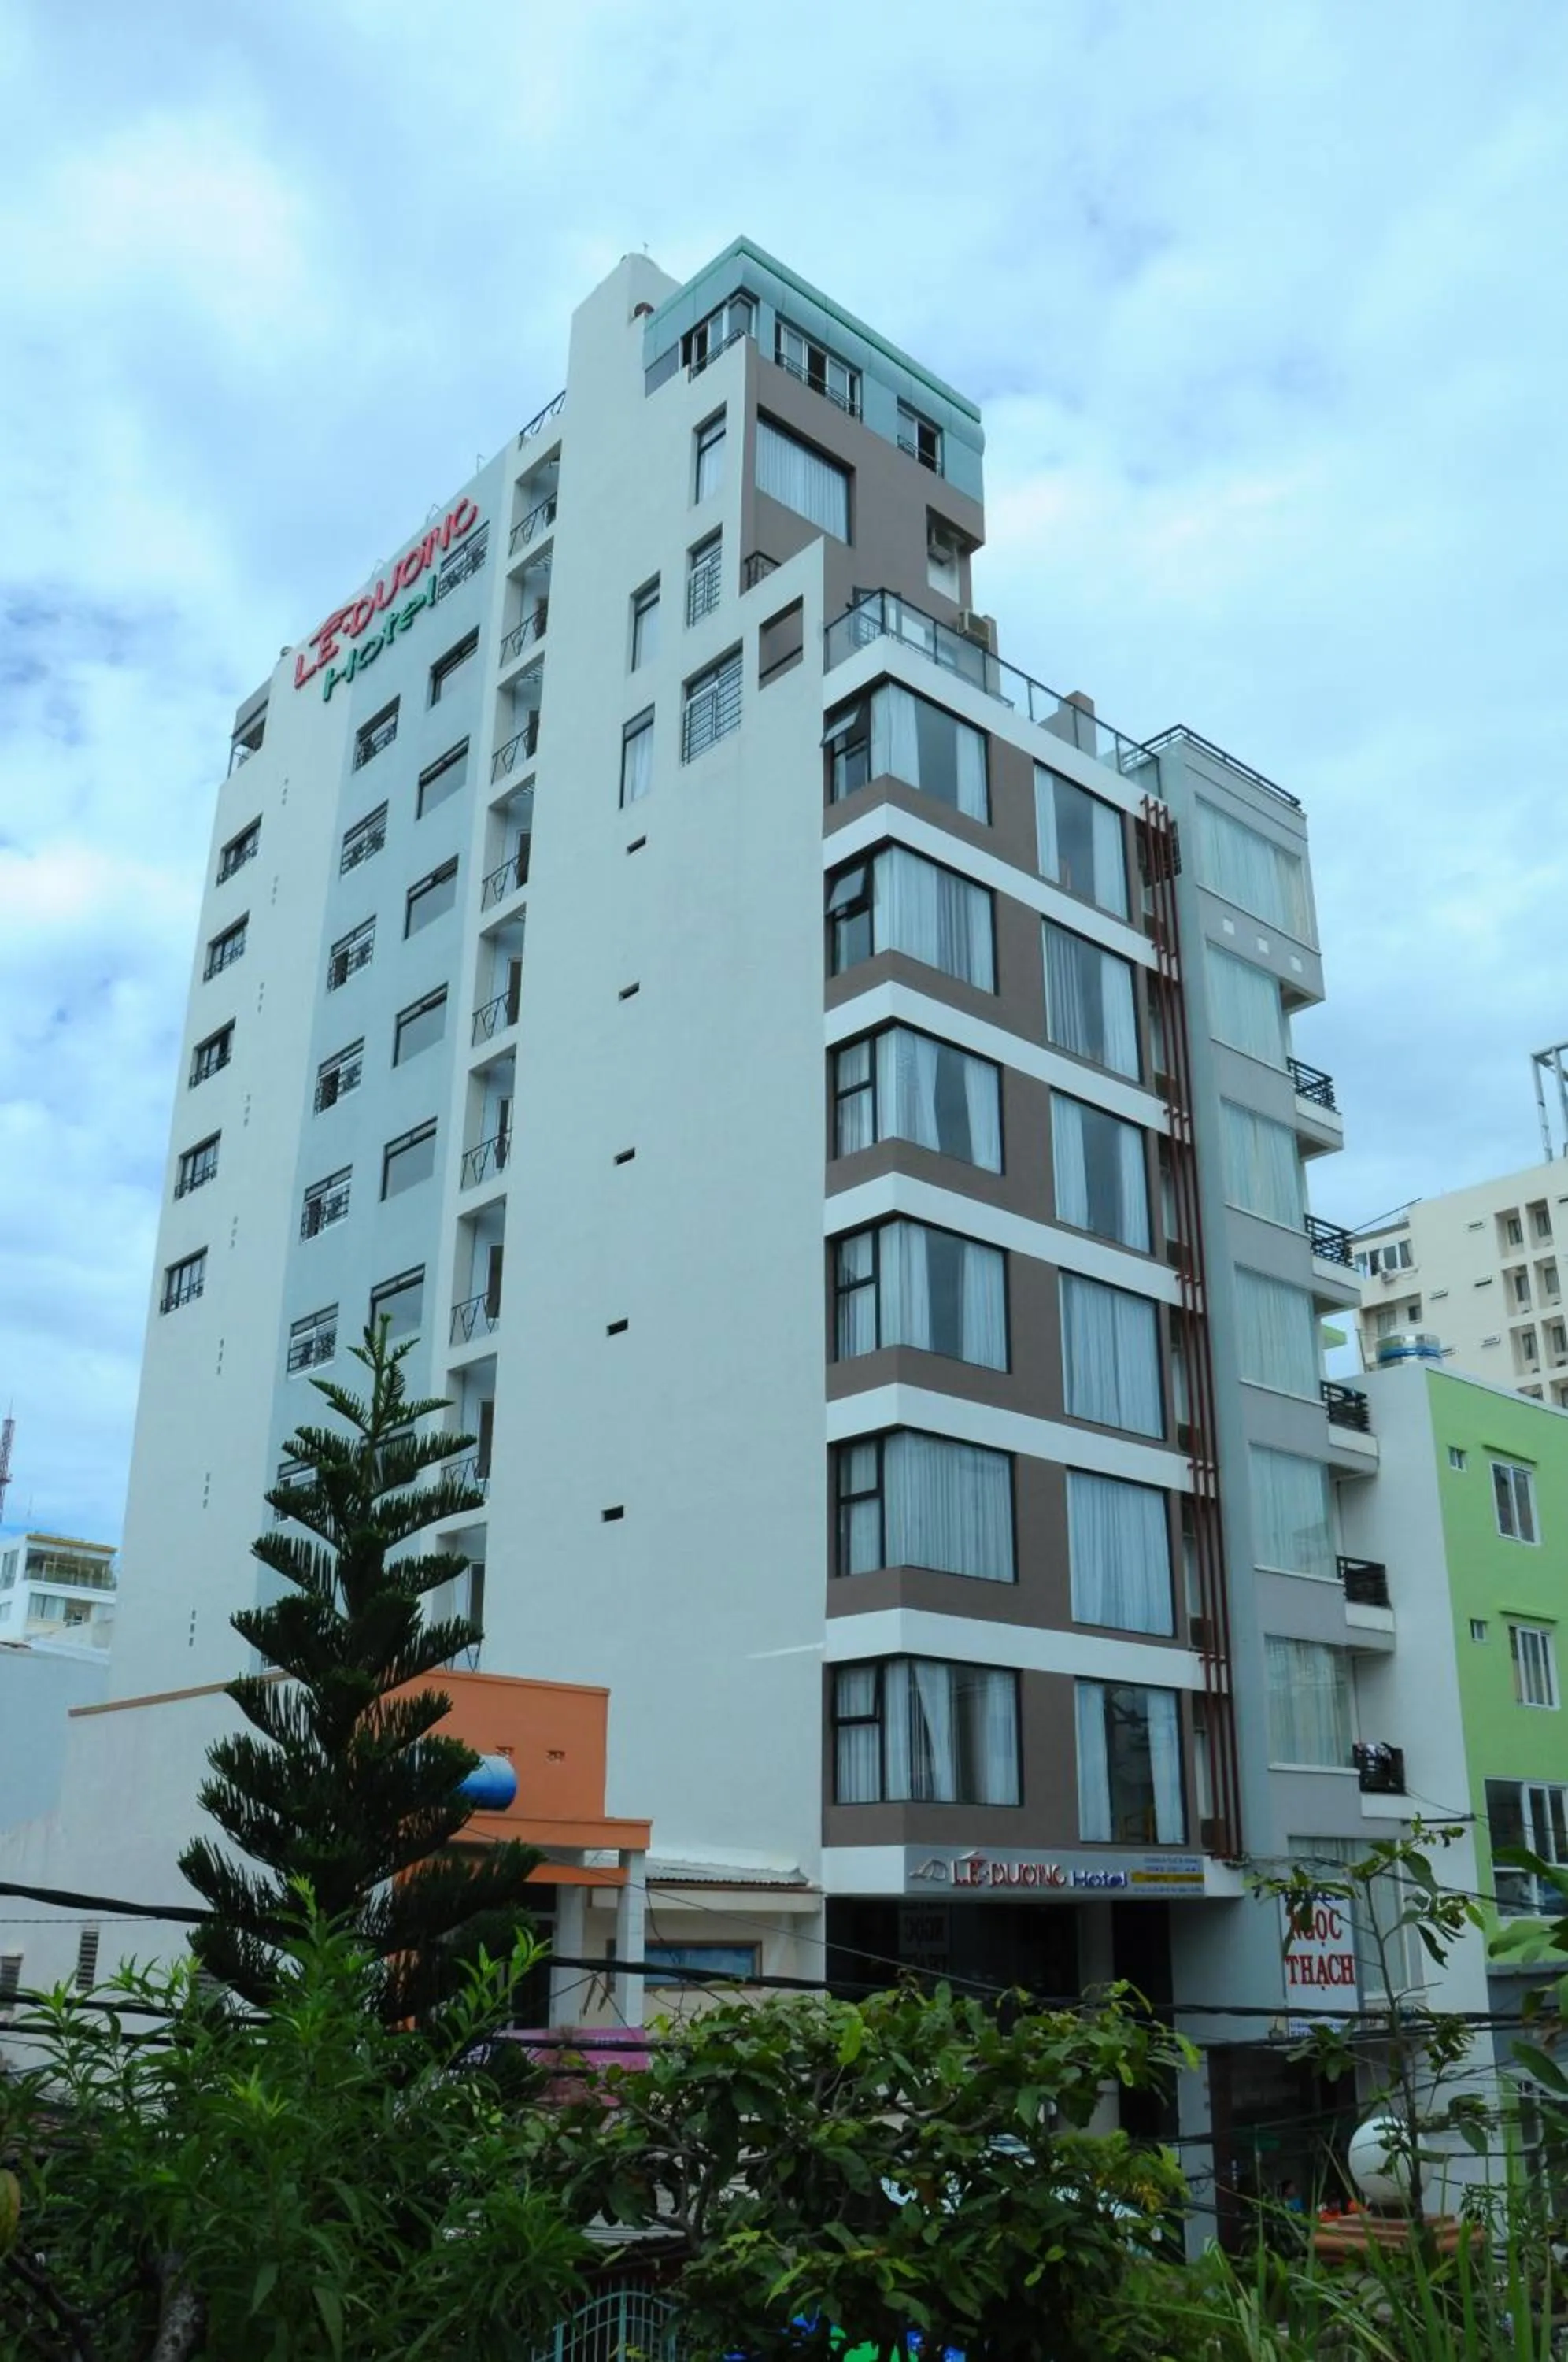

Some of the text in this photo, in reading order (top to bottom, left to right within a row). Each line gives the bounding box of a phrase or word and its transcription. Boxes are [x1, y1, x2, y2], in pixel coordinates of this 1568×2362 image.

[323, 574, 437, 702] Hotel
[1069, 1869, 1128, 1889] Hotel
[1285, 1954, 1355, 1990] THẠCH
